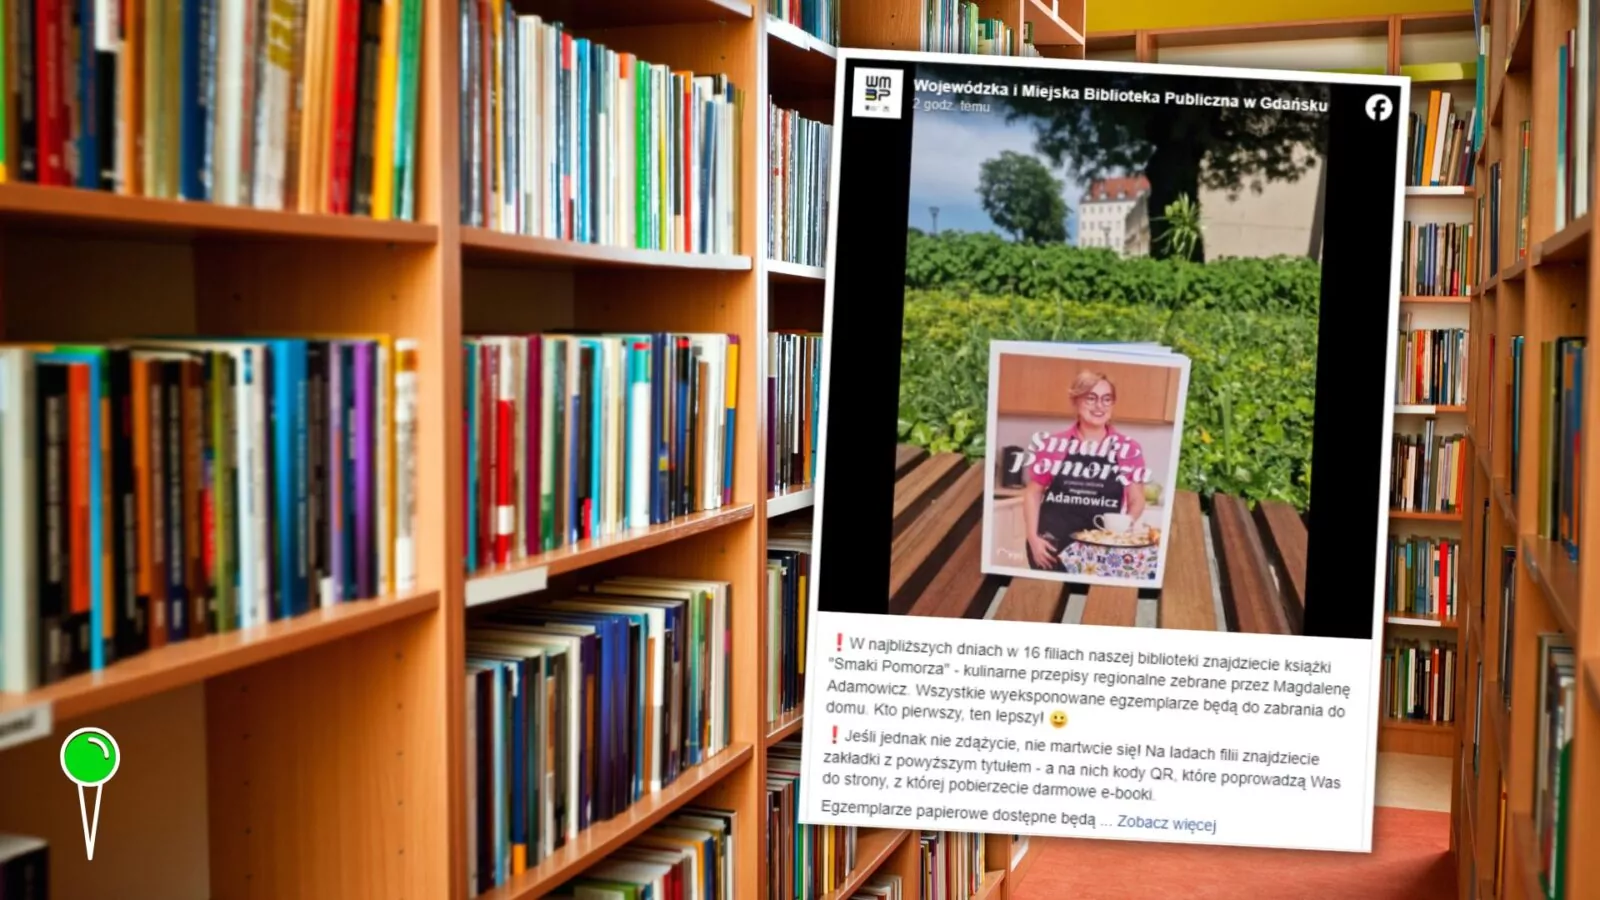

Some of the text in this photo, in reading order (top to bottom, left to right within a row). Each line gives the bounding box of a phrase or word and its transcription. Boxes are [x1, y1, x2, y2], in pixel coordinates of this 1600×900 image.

[1027, 430, 1142, 464] Smaki
[1008, 450, 1154, 486] Pomorza
[1046, 490, 1120, 508] Adamowicz
